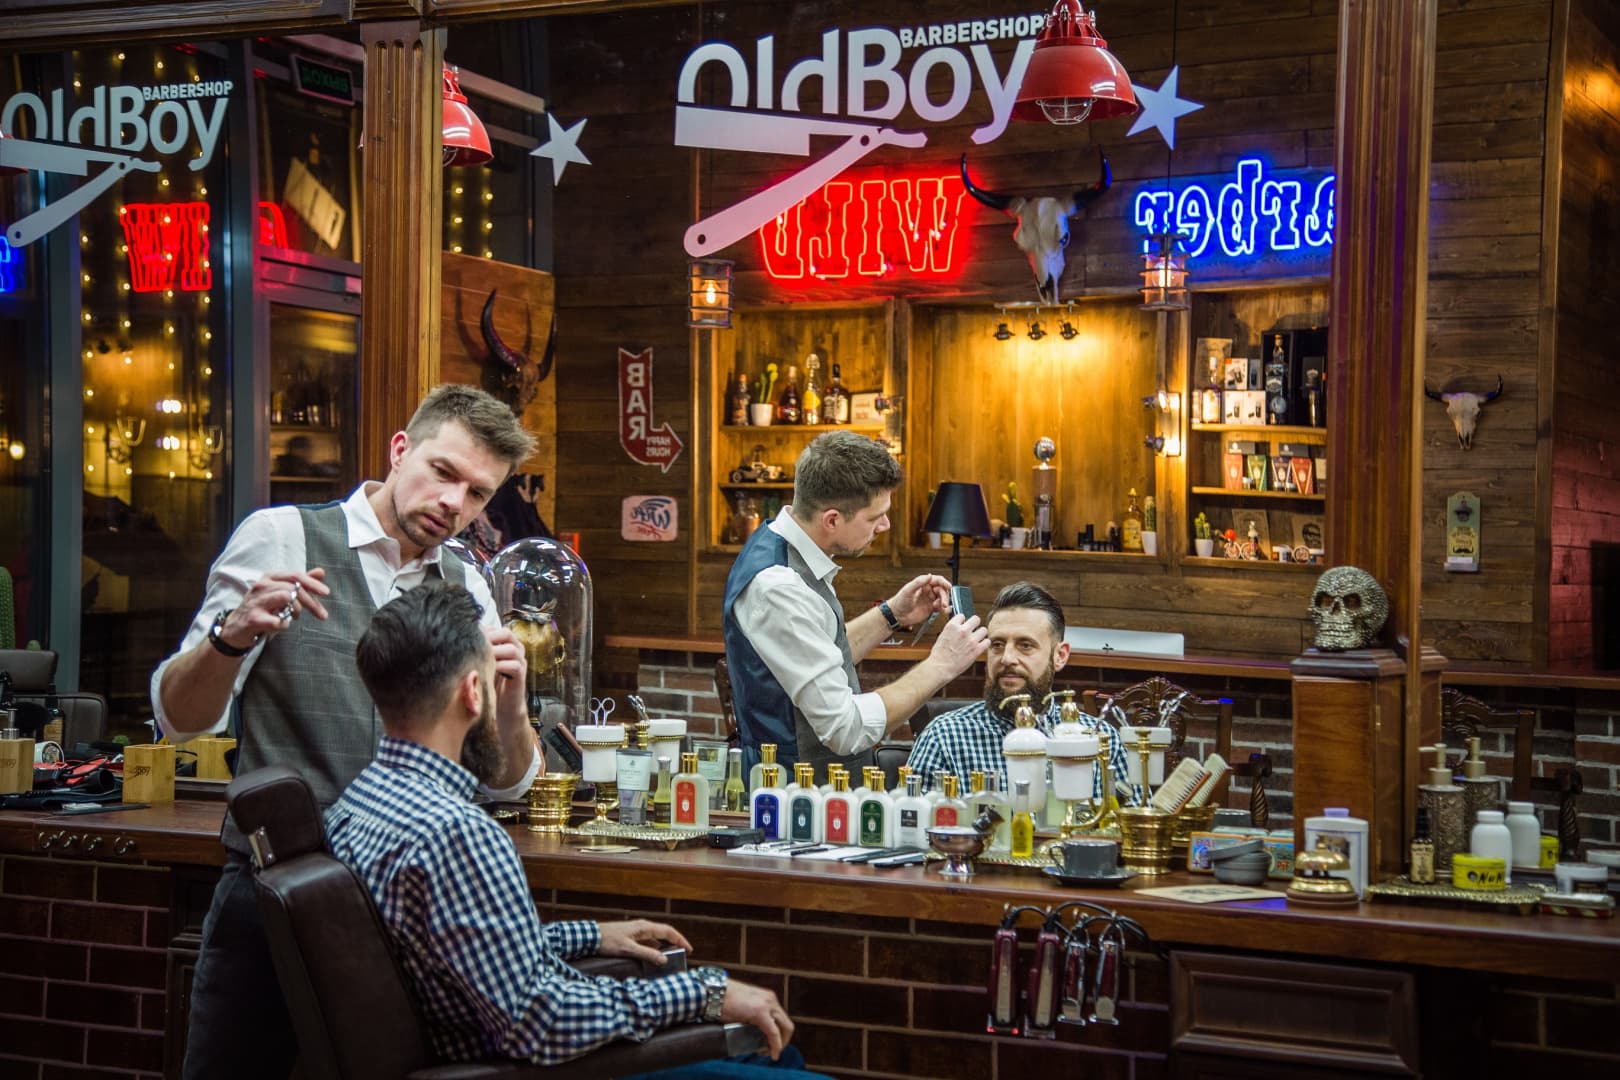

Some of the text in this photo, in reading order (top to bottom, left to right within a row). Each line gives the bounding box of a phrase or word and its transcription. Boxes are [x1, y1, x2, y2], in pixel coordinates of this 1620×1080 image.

[899, 14, 1044, 49] BARBERSHOP
[142, 80, 234, 101] BARBERSHOP
[678, 27, 1037, 145] OldBoy
[1, 85, 229, 172] OldBoy
